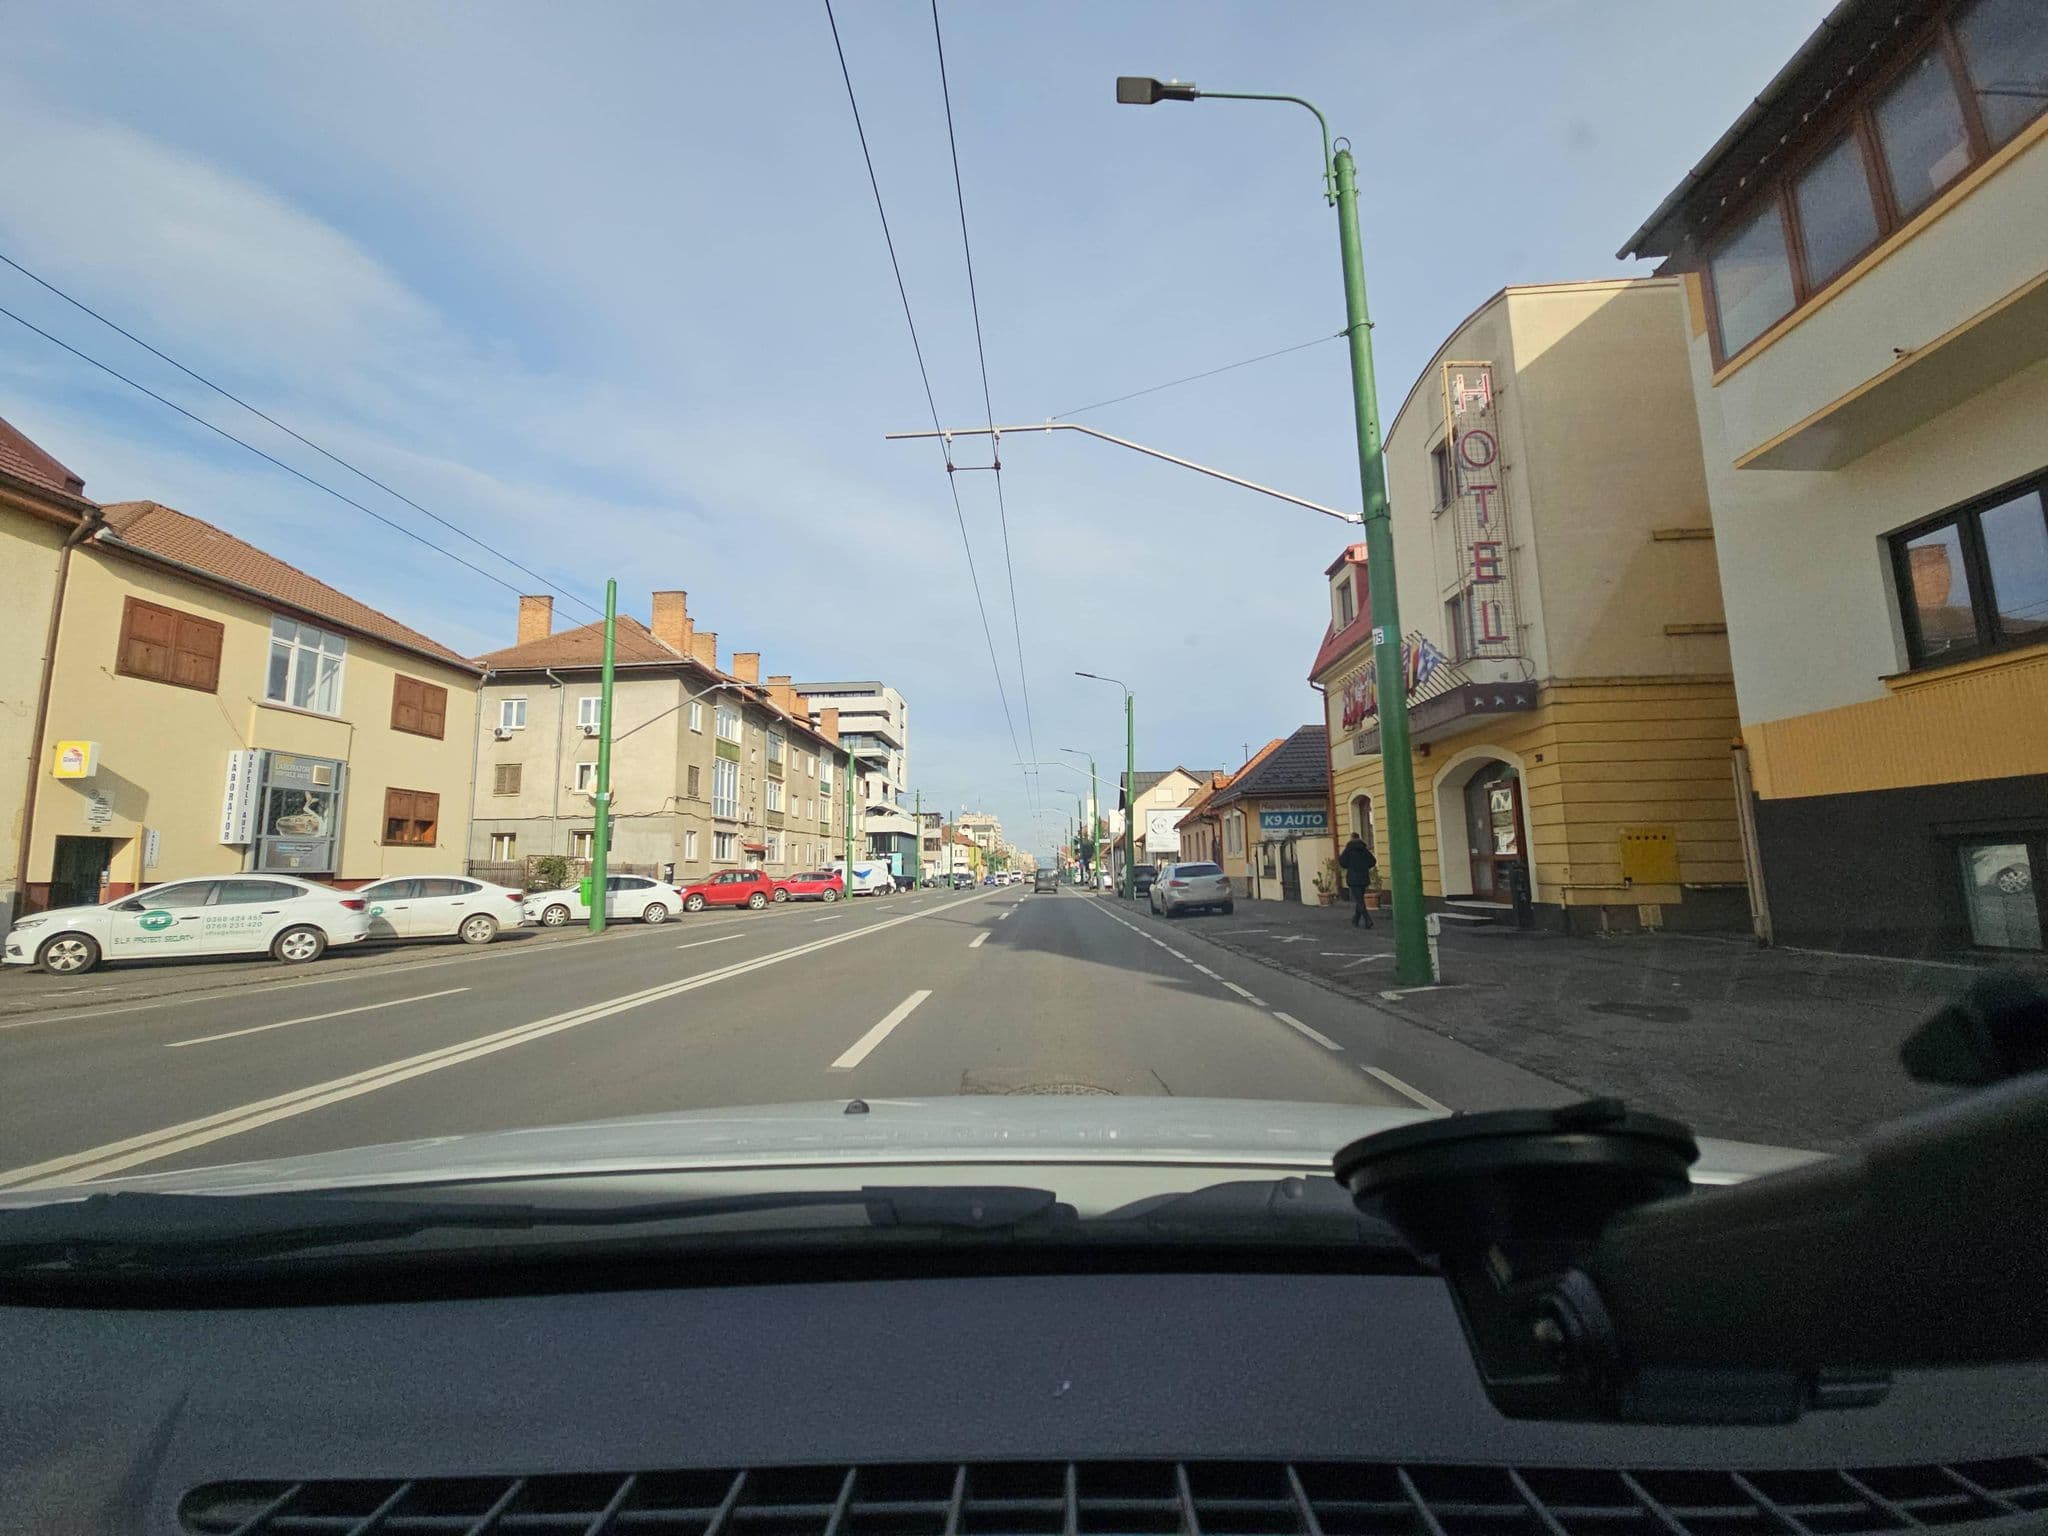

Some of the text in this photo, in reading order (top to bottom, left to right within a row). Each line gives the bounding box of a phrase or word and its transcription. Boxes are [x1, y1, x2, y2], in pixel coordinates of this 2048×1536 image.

[1455, 373, 1510, 643] HOTEL
[223, 753, 238, 841] LABORATOR
[239, 753, 255, 841] VOPSELE AUTO
[1264, 814, 1323, 826] K9 AUTO
